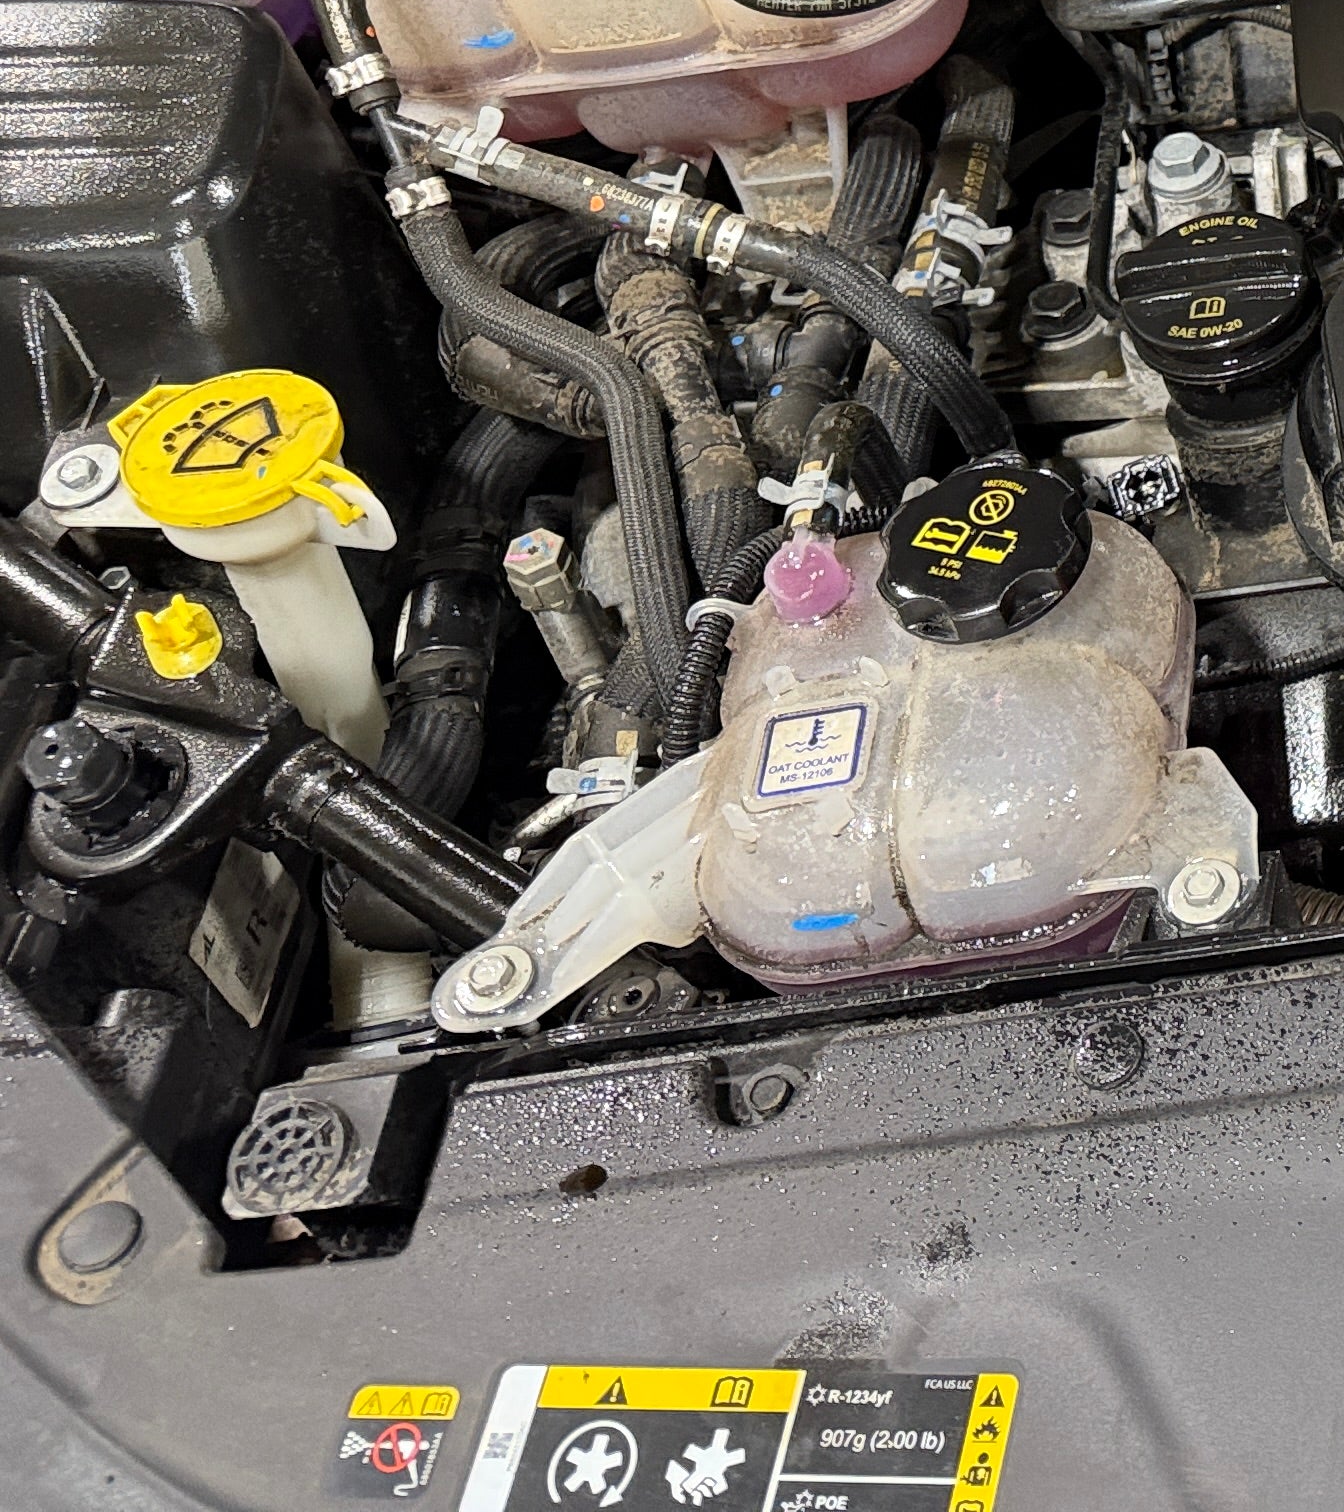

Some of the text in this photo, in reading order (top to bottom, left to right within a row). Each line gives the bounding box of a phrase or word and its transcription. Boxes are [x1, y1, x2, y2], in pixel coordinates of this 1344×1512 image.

[1178, 215, 1259, 237] ENGINE OIL
[1167, 318, 1244, 339] SAE 0W-20
[768, 752, 850, 775] OAT COOLANT
[780, 767, 834, 784] MS-12106
[924, 1378, 974, 1391] FCA US LLC
[827, 1389, 894, 1408] R-1234yf
[819, 1428, 945, 1454] 907g (2.00 lb)
[814, 1495, 849, 1511] POE
